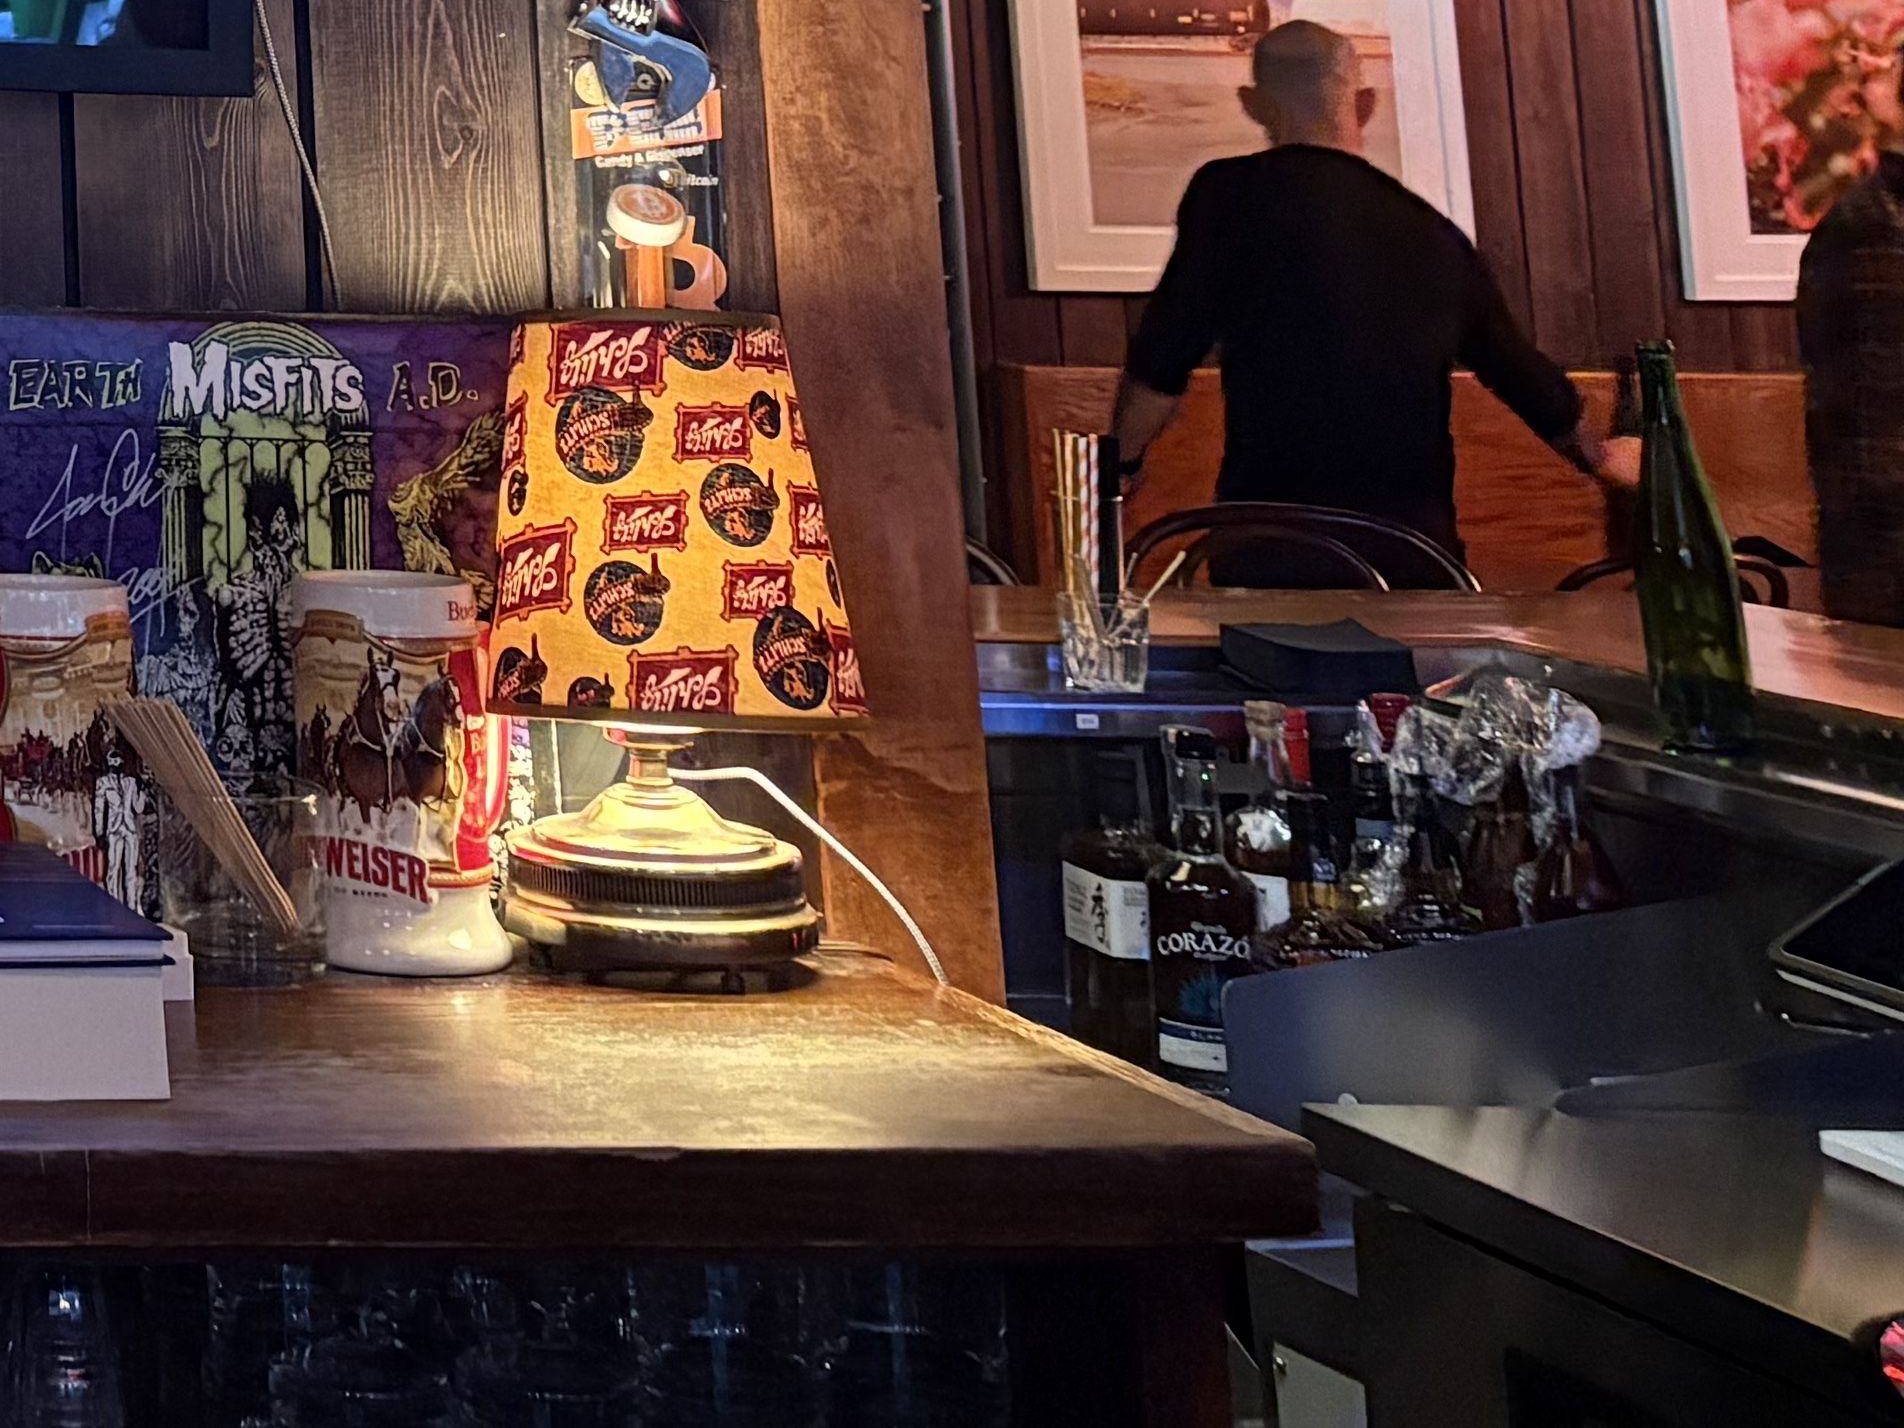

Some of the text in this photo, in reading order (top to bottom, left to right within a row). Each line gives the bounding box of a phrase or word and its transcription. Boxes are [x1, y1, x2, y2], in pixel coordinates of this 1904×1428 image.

[7, 339, 366, 419] EARTH MISFITS
[1157, 929, 1251, 961] CORAZÓ
